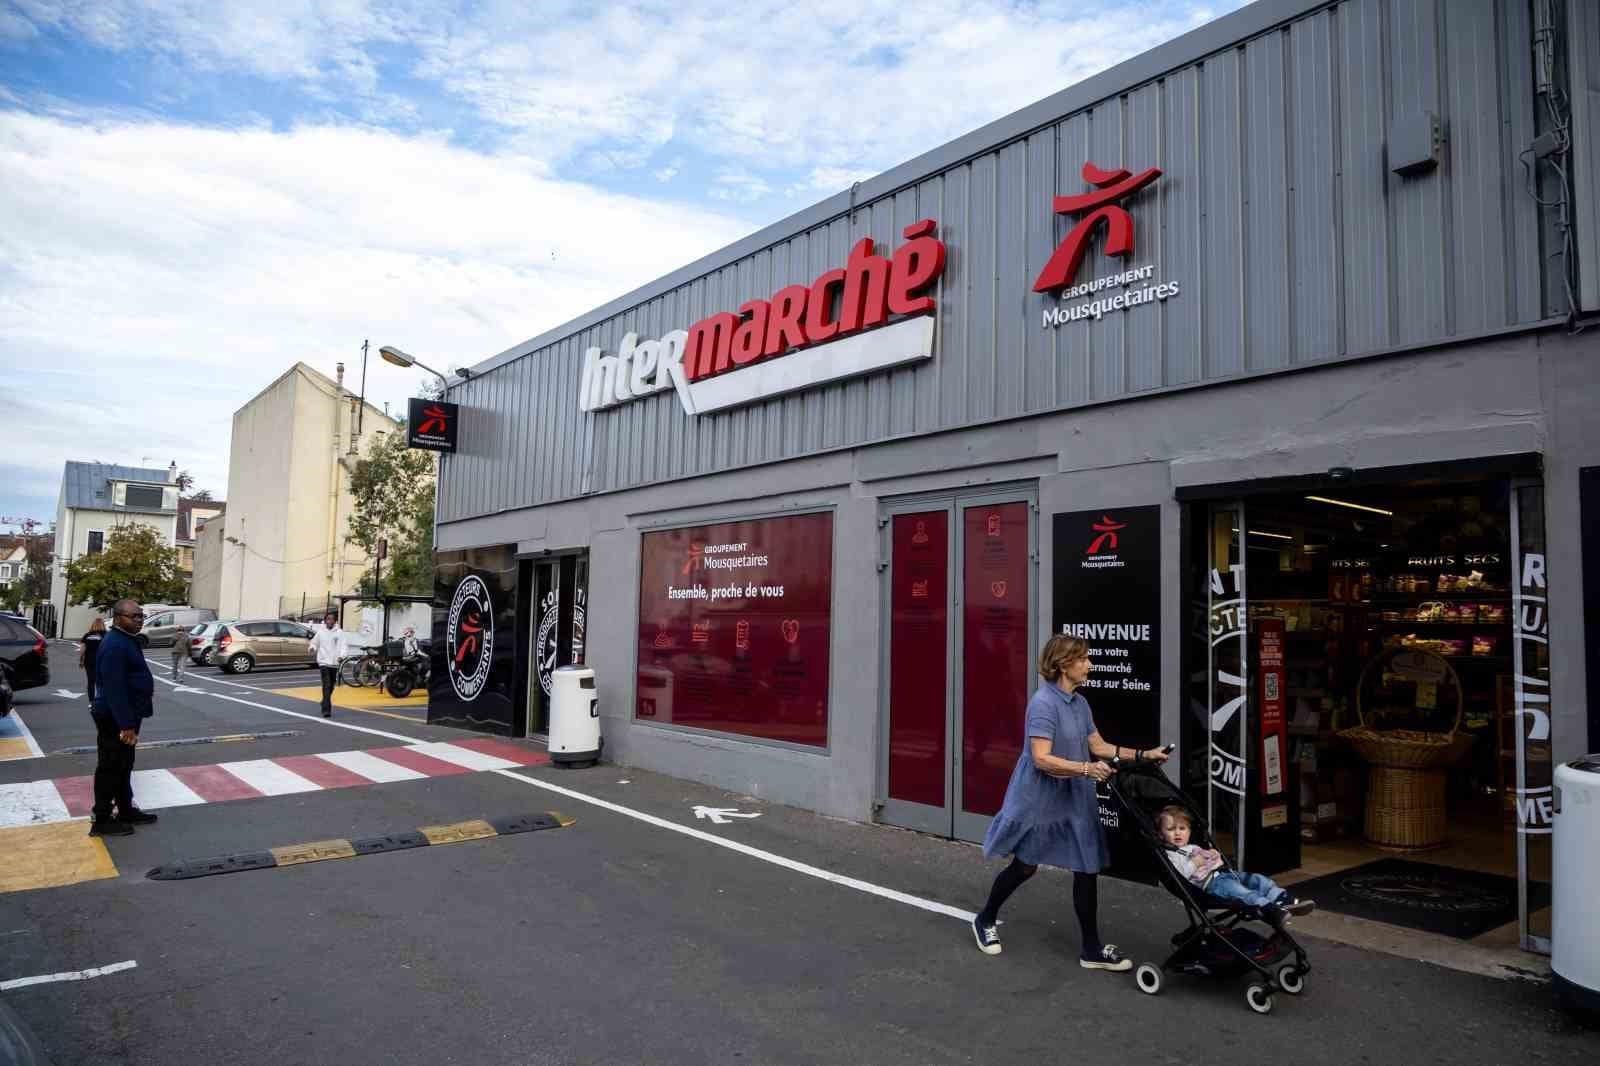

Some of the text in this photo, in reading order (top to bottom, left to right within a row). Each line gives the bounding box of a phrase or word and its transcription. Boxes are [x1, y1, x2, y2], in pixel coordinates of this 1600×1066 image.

[1062, 265, 1154, 300] GROUPEMENT
[1042, 281, 1180, 328] Mousquetaires
[704, 543, 747, 554] GROUPEMENT
[704, 553, 769, 572] Mousquetaires
[1408, 553, 1501, 566] FRUITS SECS
[668, 581, 784, 602] Ensemble, proche de vous
[1063, 623, 1150, 641] BIENVENUE
[1087, 647, 1102, 656] ans
[1088, 661, 1132, 674] ermarché
[1104, 680, 1120, 689] sur
[1122, 678, 1151, 691] Seine
